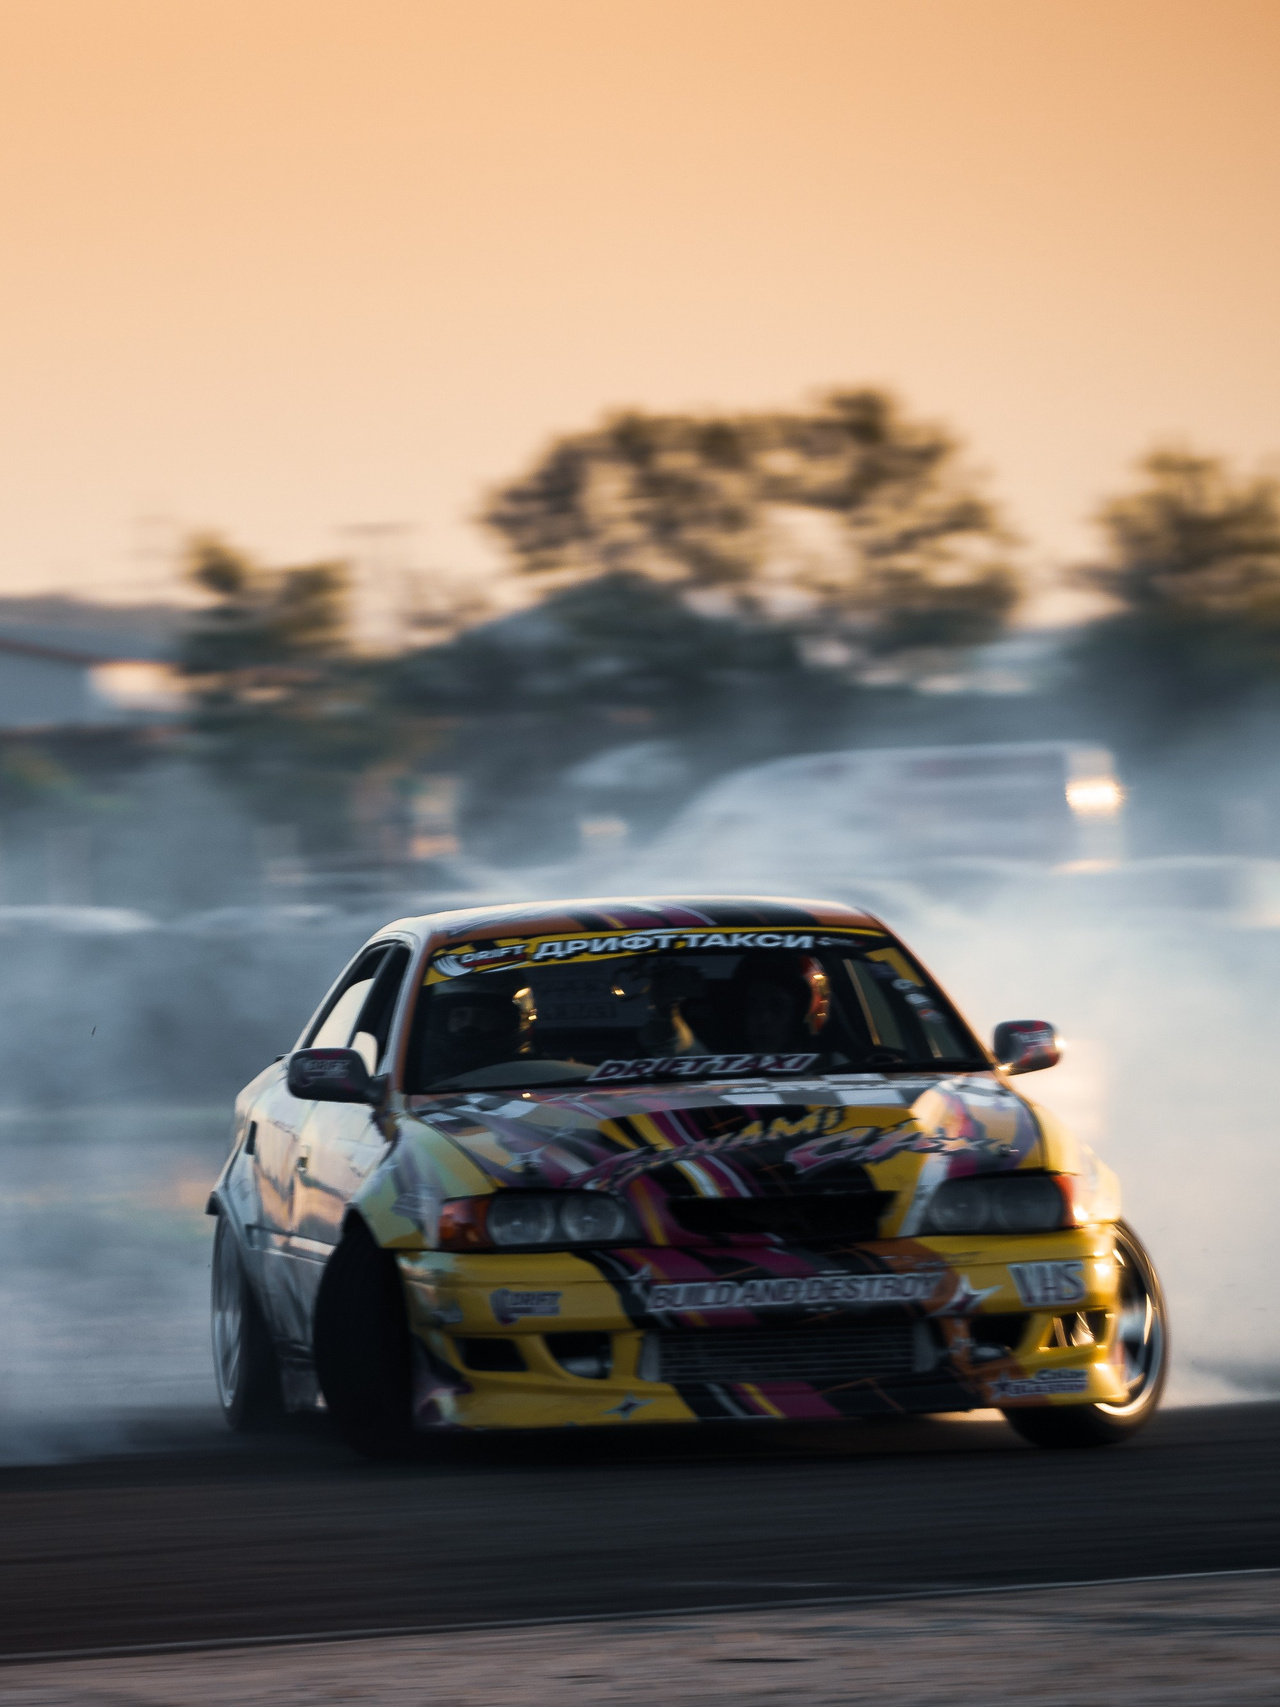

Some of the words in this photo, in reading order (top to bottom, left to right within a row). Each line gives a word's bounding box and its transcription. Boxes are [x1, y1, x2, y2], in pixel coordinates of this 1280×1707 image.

[461, 944, 528, 963] DRIFT
[532, 933, 677, 960] ДРИФТ
[681, 933, 815, 949] ТАКСИ
[593, 1057, 716, 1079] DRIFT
[709, 1054, 813, 1072] TAXI
[650, 1283, 737, 1309] BUILD
[736, 1279, 803, 1306] AND
[804, 1272, 946, 1303] DESTROY
[1008, 1261, 1085, 1305] VHS
